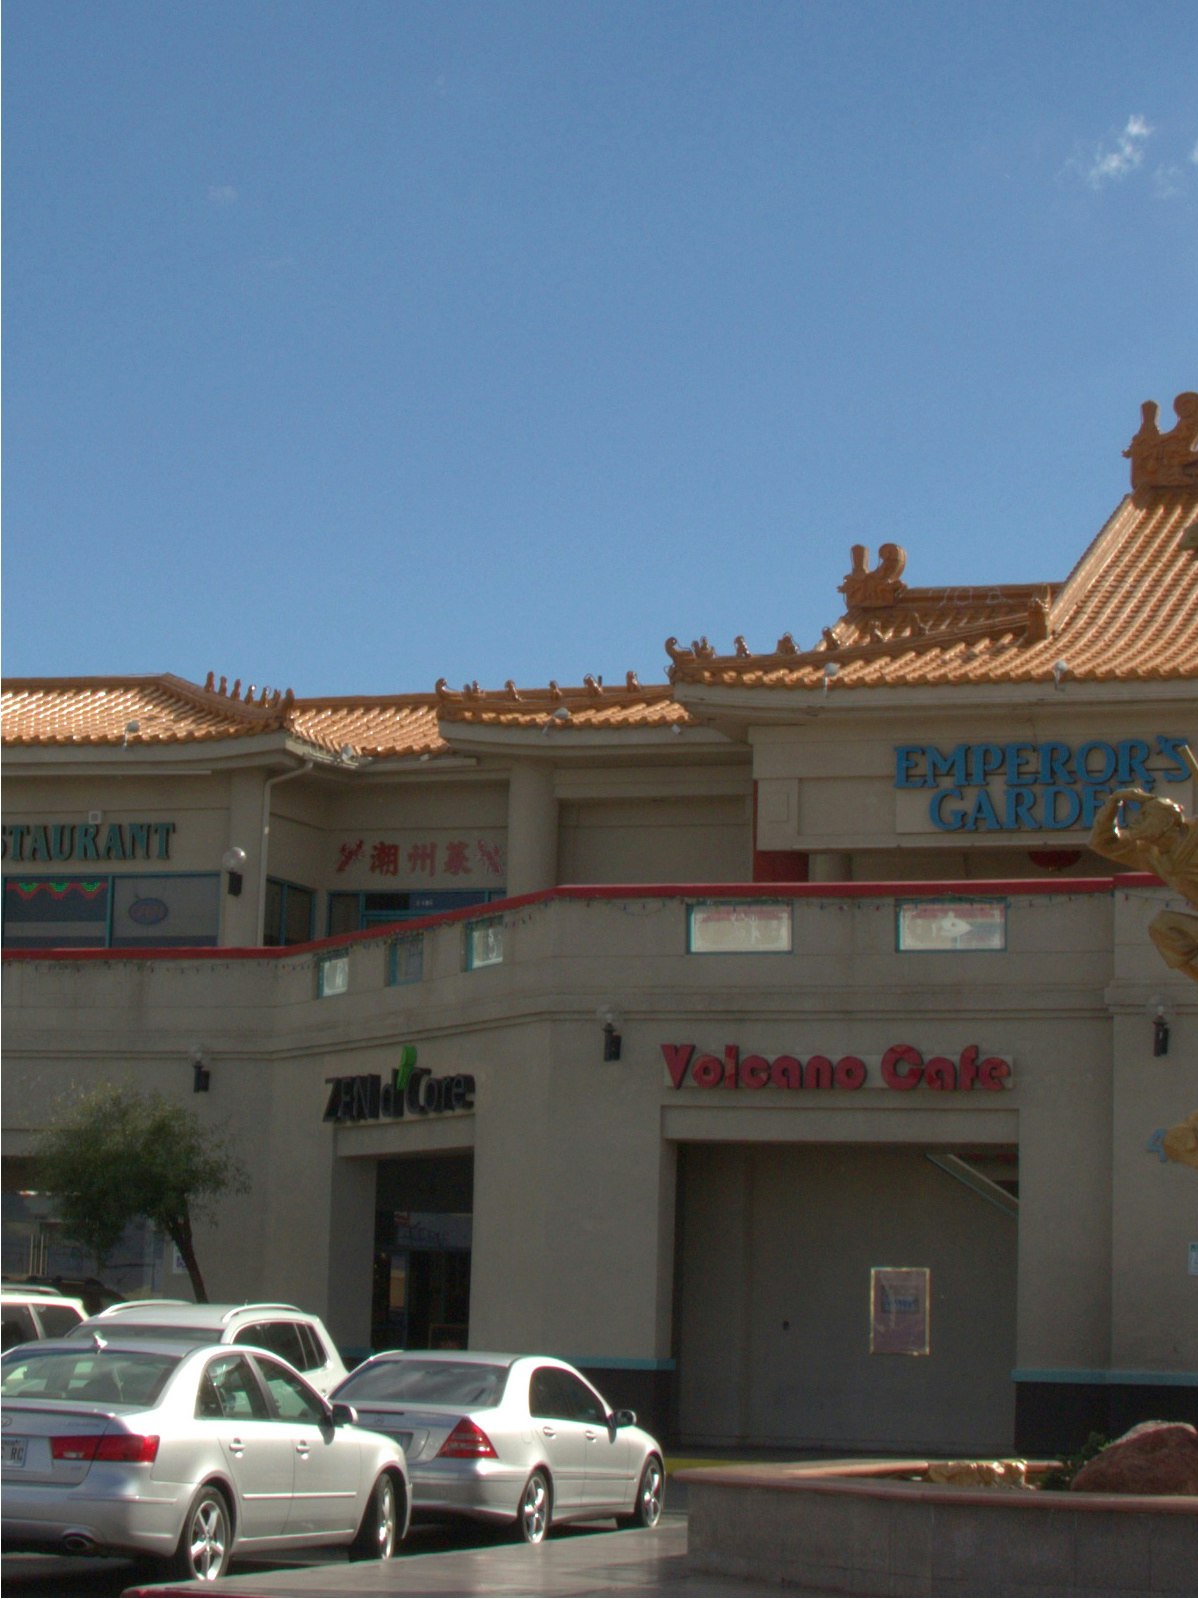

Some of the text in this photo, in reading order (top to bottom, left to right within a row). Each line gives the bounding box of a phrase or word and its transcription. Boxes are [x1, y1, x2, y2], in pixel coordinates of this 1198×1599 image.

[893, 735, 1192, 789] EMPEROR'S
[1, 822, 177, 862] TAURANT
[660, 1043, 1012, 1092] Volcano Cafe
